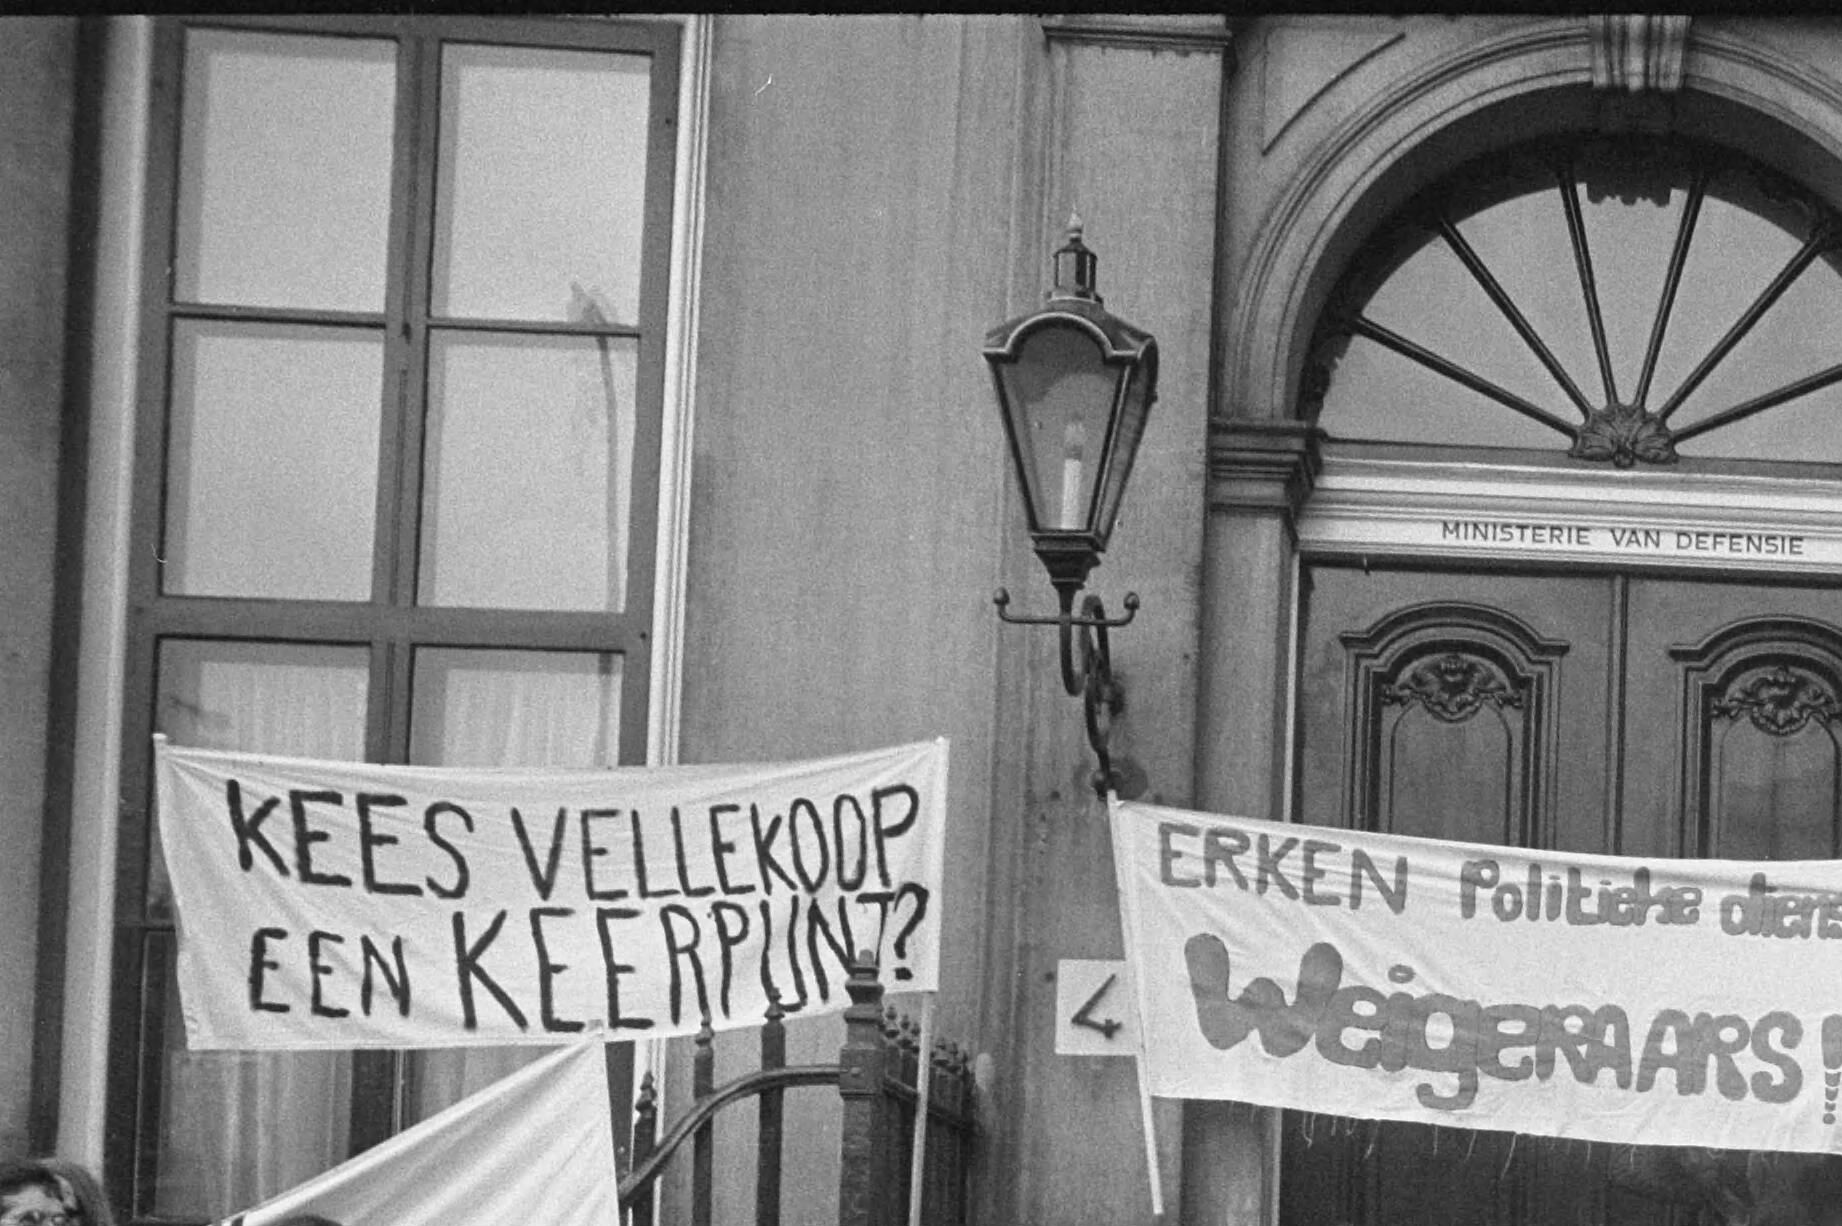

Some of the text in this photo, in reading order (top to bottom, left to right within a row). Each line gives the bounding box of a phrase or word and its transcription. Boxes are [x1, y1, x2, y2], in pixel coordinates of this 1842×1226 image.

[1441, 520, 1805, 556] MINISTERIE VAN DEFENSIE
[226, 778, 920, 901] KEES VELLEKOOP
[1158, 821, 1409, 915] ERKEN
[248, 882, 930, 1033] EEN KEERPUNT?
